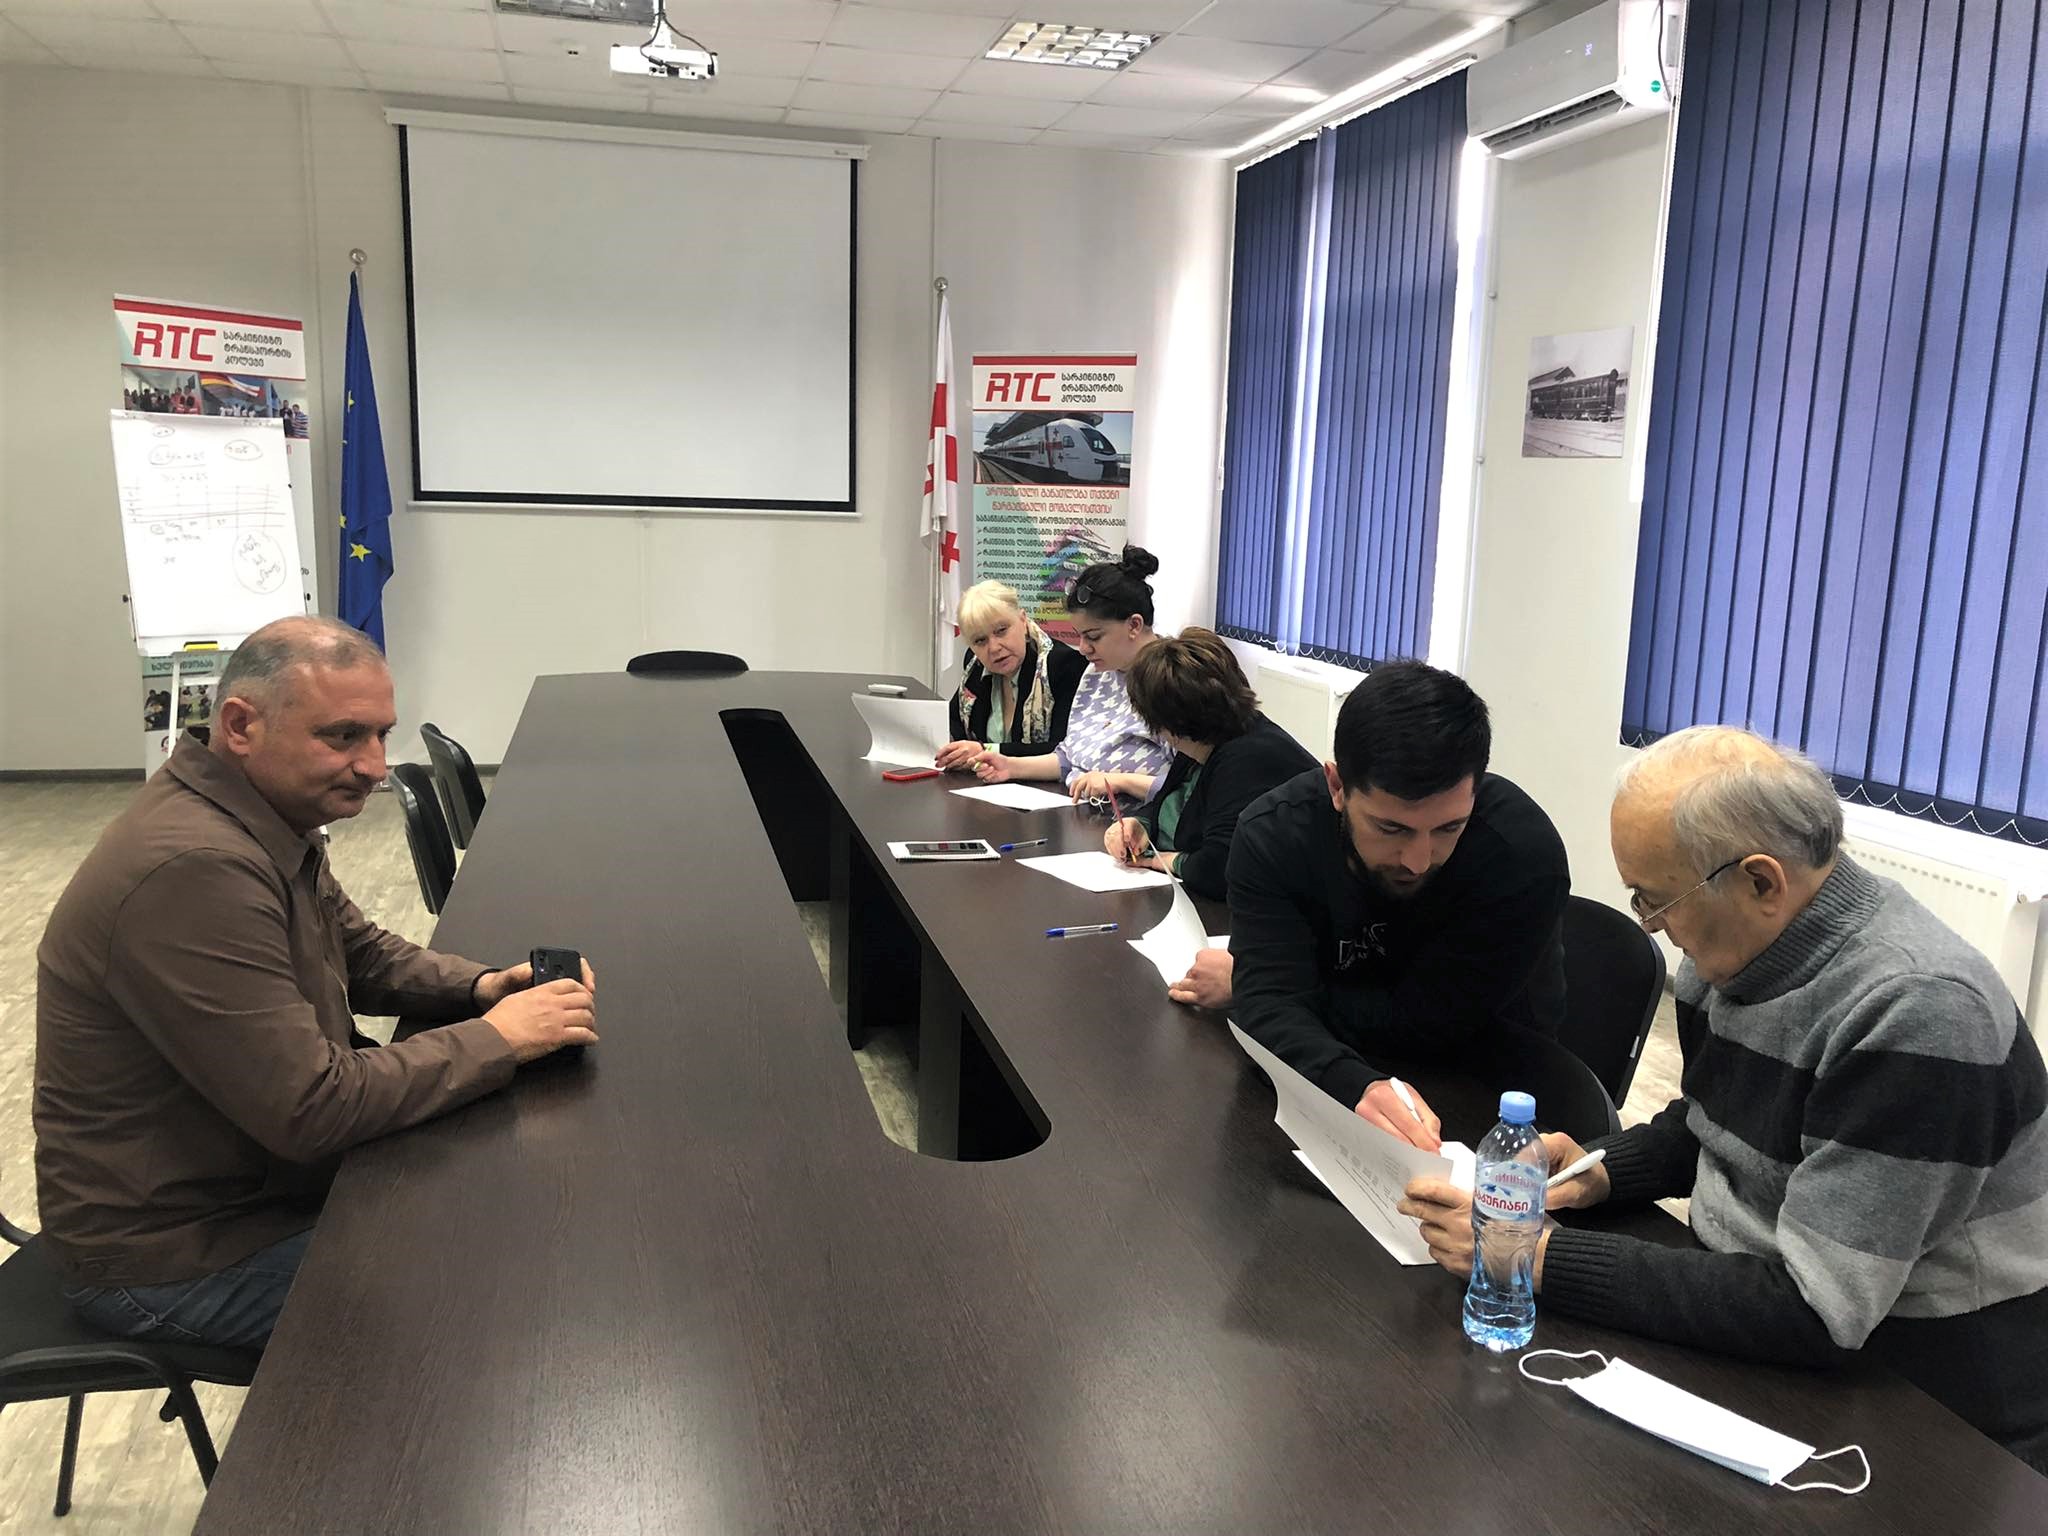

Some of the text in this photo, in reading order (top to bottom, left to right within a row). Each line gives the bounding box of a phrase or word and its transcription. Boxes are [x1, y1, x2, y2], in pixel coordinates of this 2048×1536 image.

[133, 322, 216, 362] RTC
[223, 331, 283, 346] სარკინიგზო
[224, 343, 292, 359] ტრანსპორტის
[225, 355, 265, 367] კოლეჯი
[1061, 372, 1116, 382] სარკინიგზო
[986, 373, 1056, 402] RTC
[1061, 383, 1124, 393] ტრანსპორტის
[1061, 394, 1097, 403] კოლეჯი
